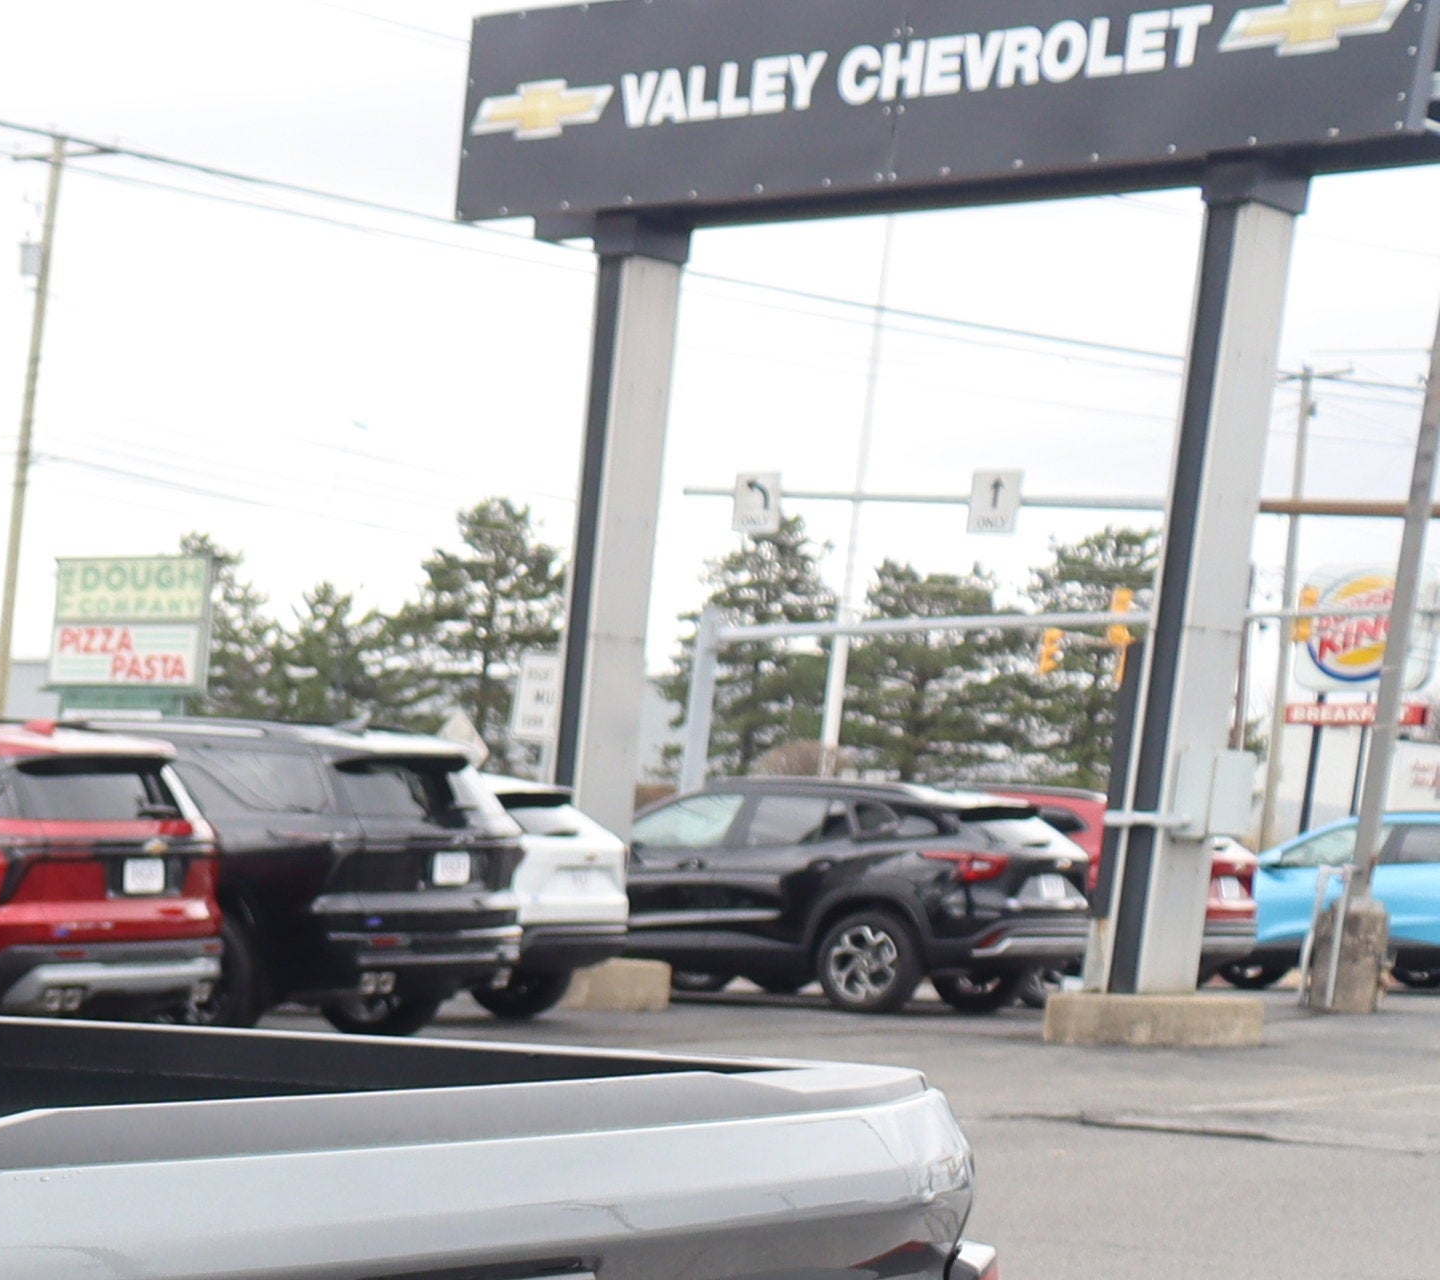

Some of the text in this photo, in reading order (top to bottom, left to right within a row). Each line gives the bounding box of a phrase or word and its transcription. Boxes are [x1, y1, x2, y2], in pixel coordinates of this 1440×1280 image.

[621, 4, 1213, 128] VALLEY CHEVROLET
[740, 513, 770, 526] ONLY
[977, 513, 1007, 528] ONLY
[82, 563, 202, 592] DOUGH
[80, 597, 201, 614] COMPANY
[59, 626, 133, 653] PIZZA
[111, 653, 187, 680] PASTA
